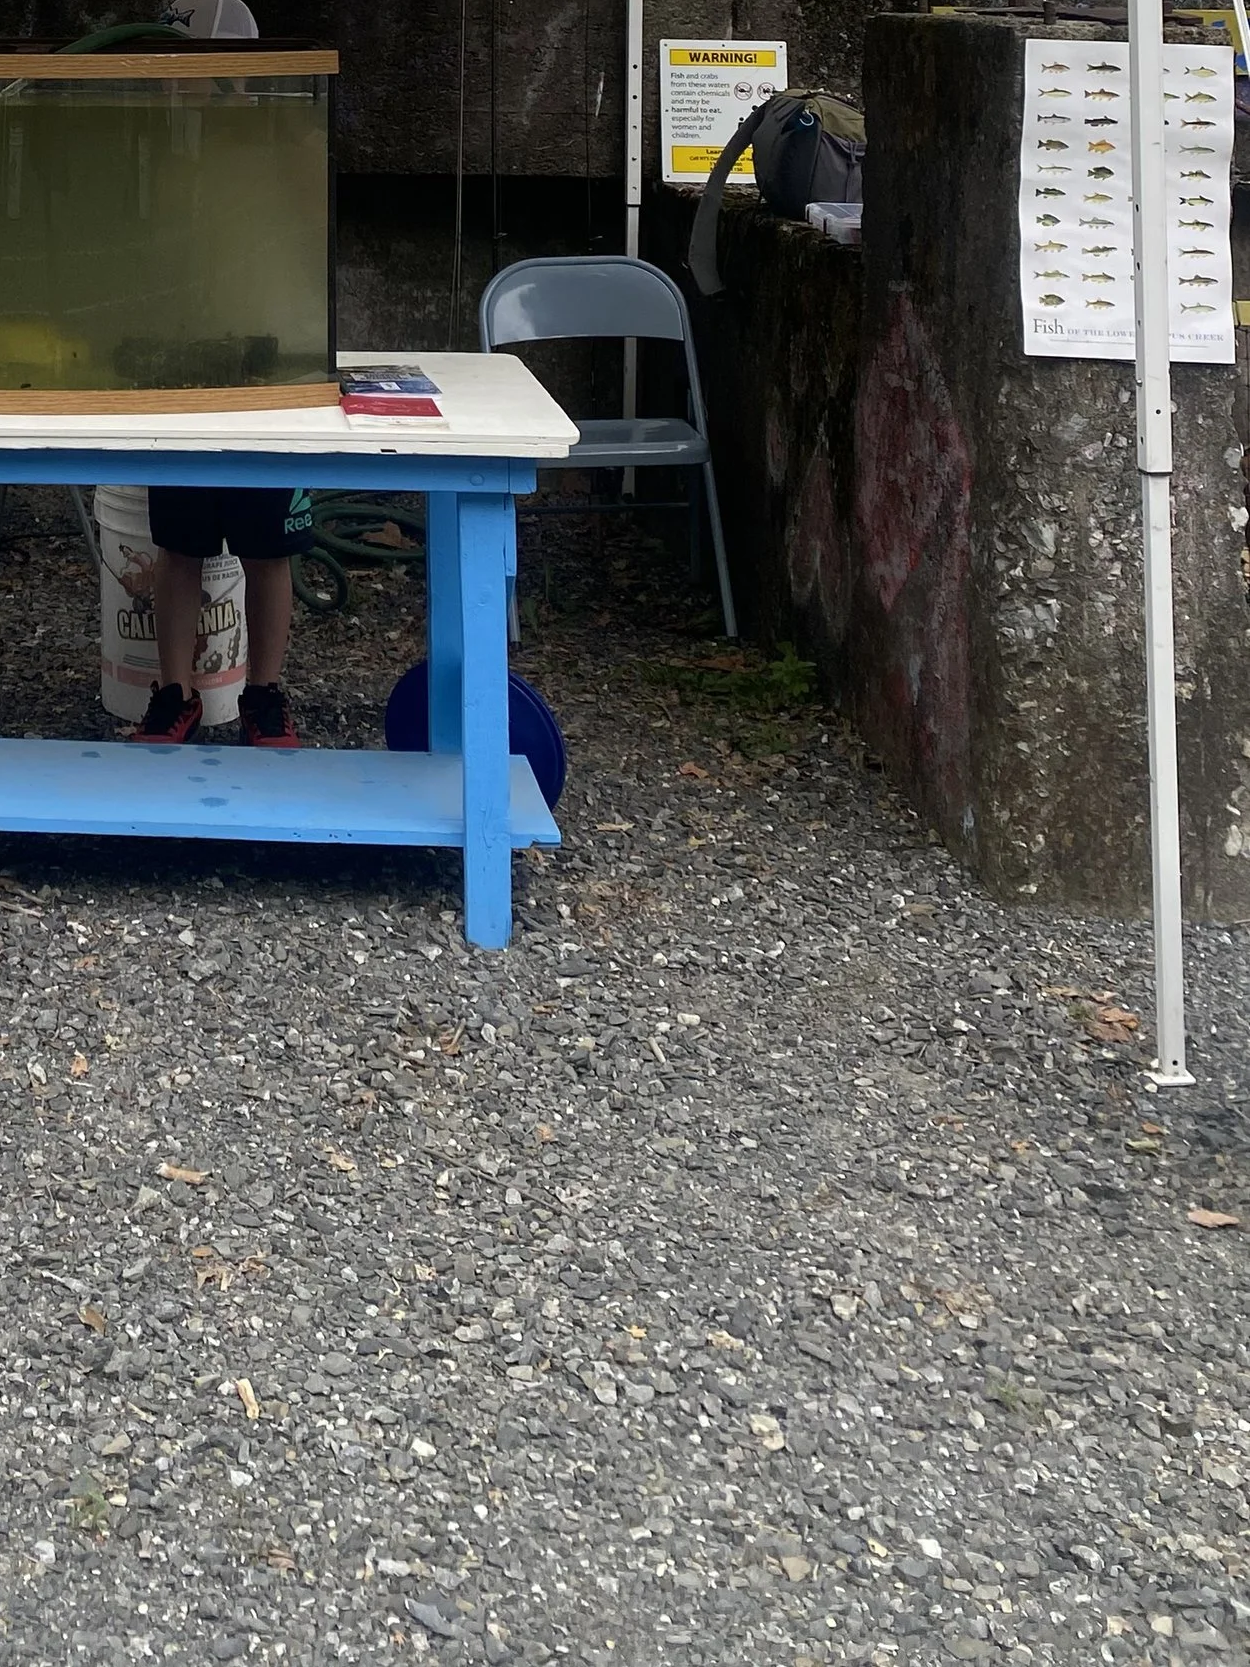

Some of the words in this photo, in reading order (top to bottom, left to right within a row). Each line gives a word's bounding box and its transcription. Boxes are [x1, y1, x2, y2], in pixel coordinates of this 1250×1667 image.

[689, 52, 757, 64] WARNING!
[1033, 318, 1064, 334] Fish
[1188, 333, 1224, 342] CREEK
